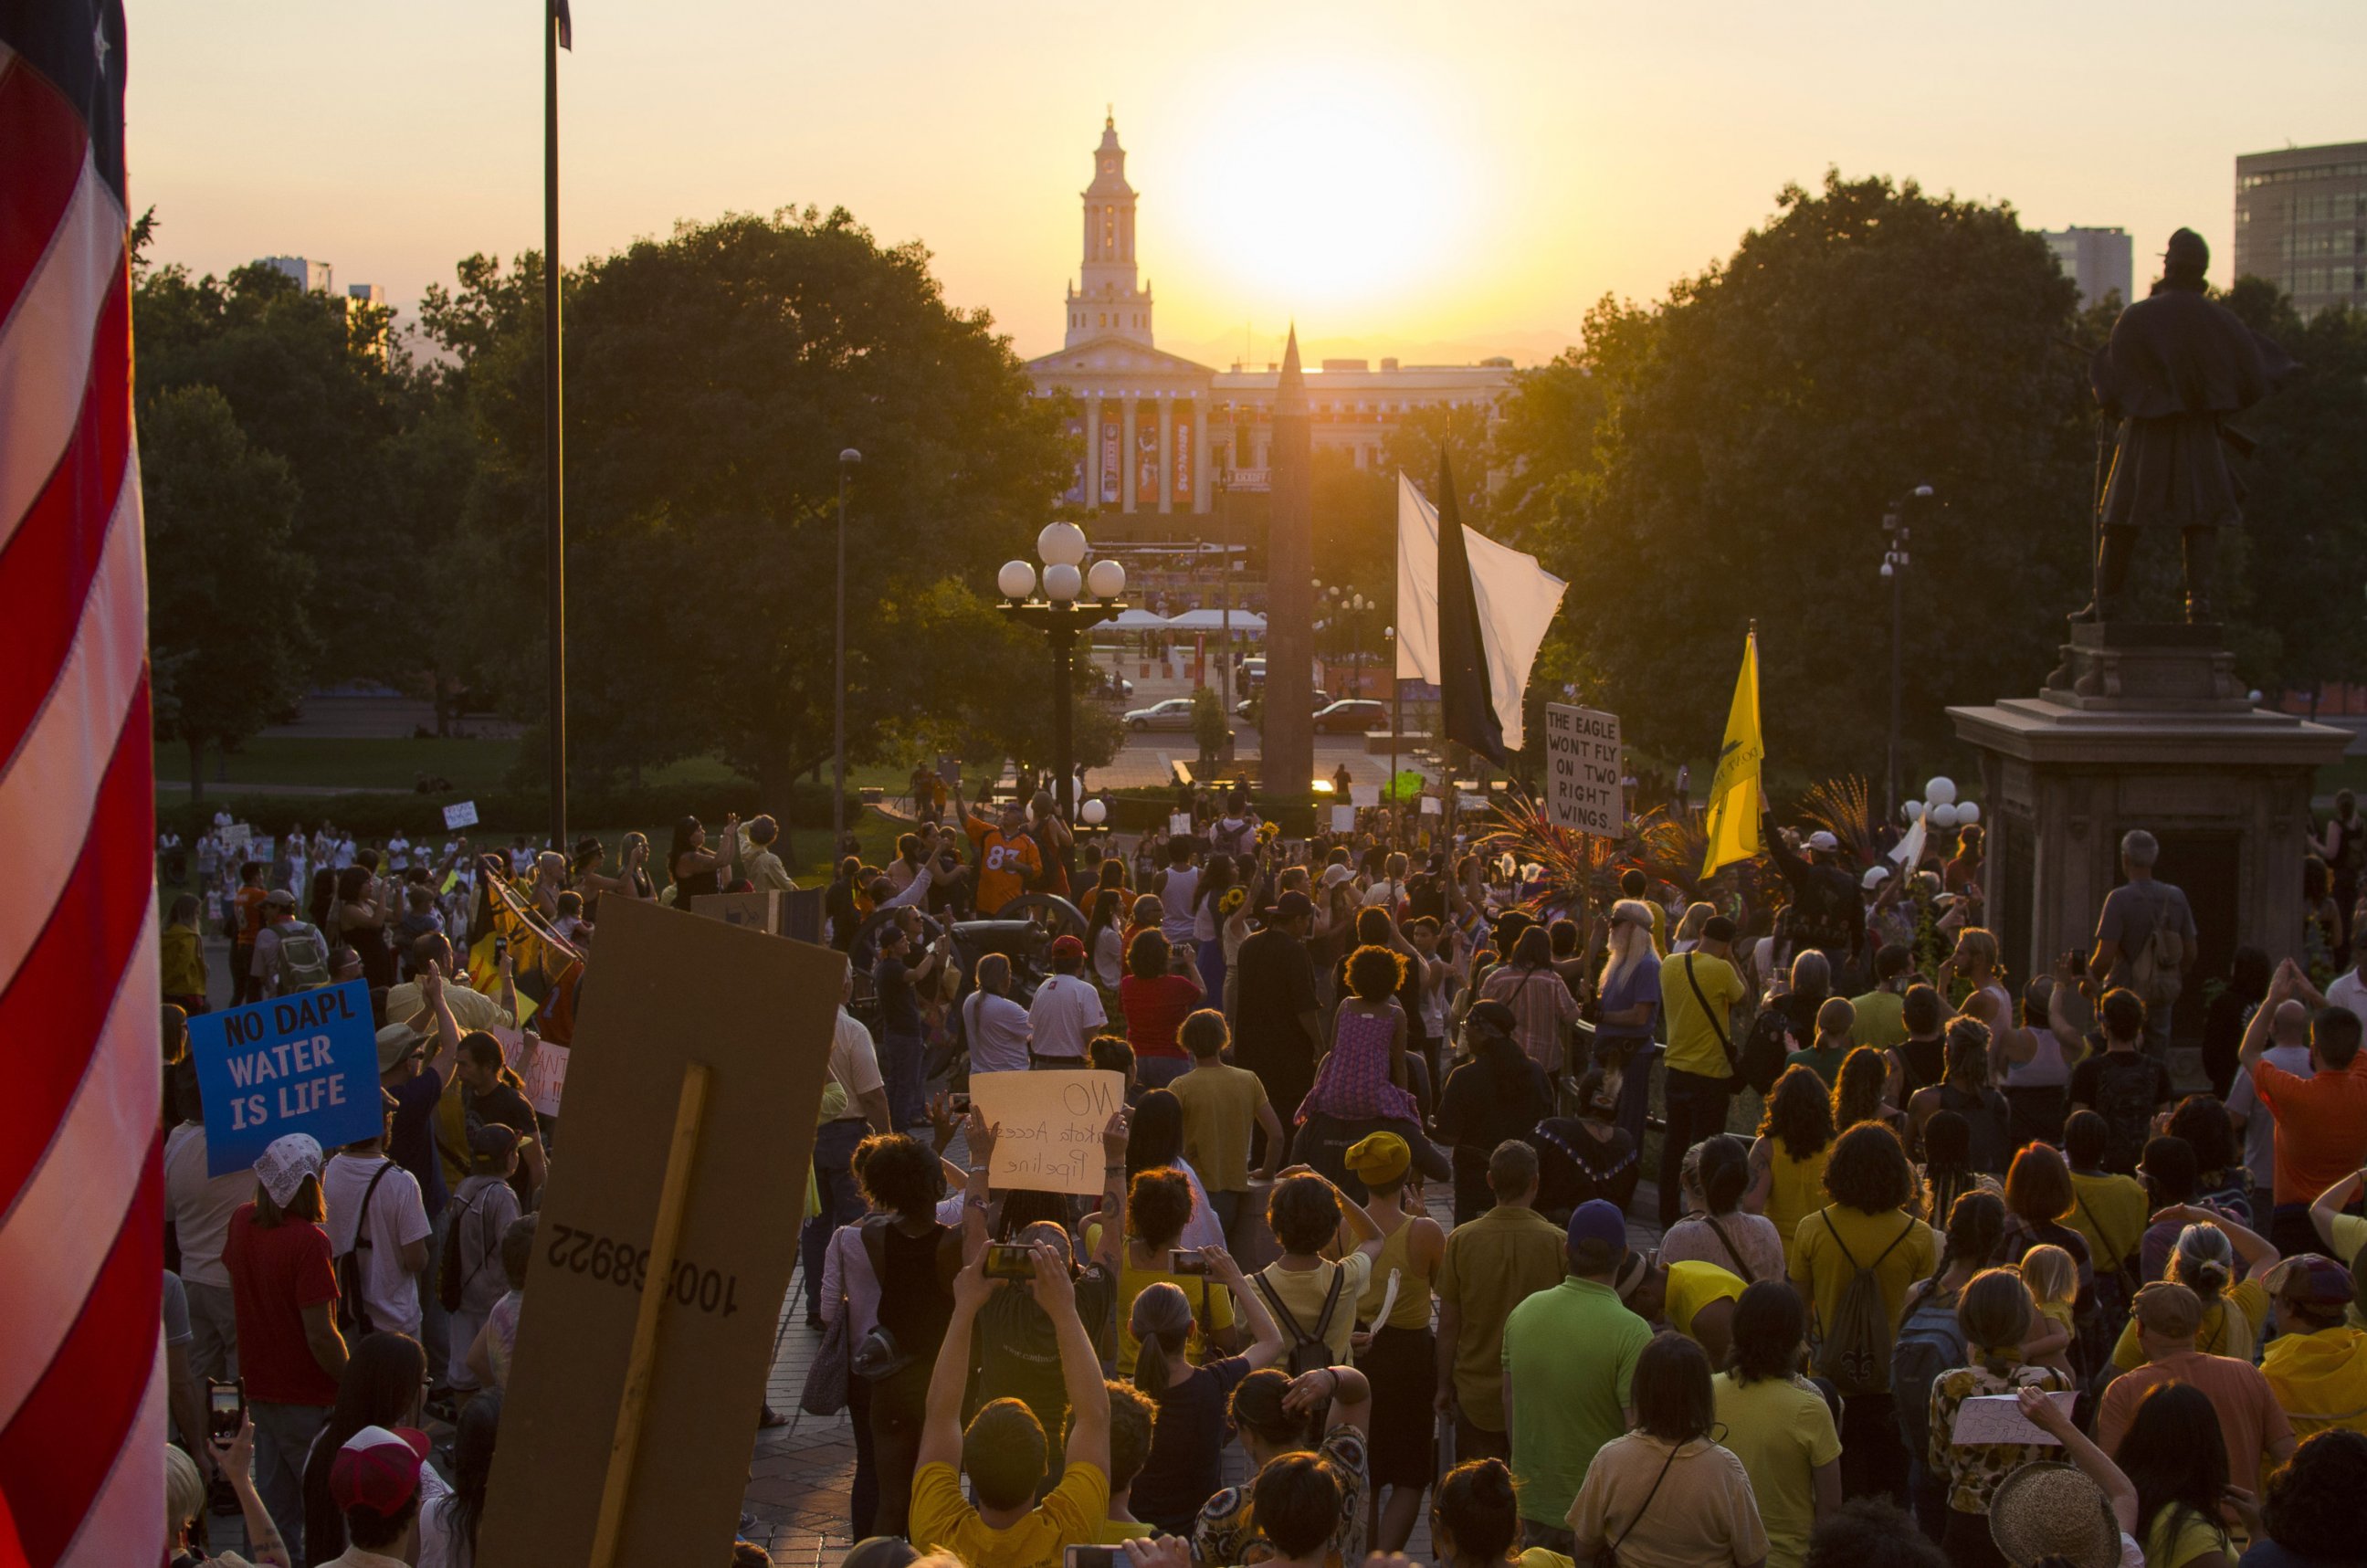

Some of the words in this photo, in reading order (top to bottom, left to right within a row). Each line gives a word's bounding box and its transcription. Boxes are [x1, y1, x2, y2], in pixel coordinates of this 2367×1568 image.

[1178, 424, 1189, 491] BRONCOS
[1547, 711, 1570, 731] THE
[1576, 716, 1616, 741] EAGLE
[1548, 733, 1591, 757] WONT
[1594, 743, 1618, 763] FLY
[1556, 758, 1574, 777] ON
[1583, 763, 1616, 785] TWO
[1559, 781, 1611, 806] RIGHT
[1557, 802, 1613, 831] WINGS.
[224, 1012, 264, 1047] NO
[276, 990, 355, 1033] DAPL
[226, 1035, 334, 1089] WATER
[230, 1092, 268, 1131] IS
[279, 1073, 346, 1120] LIFE
